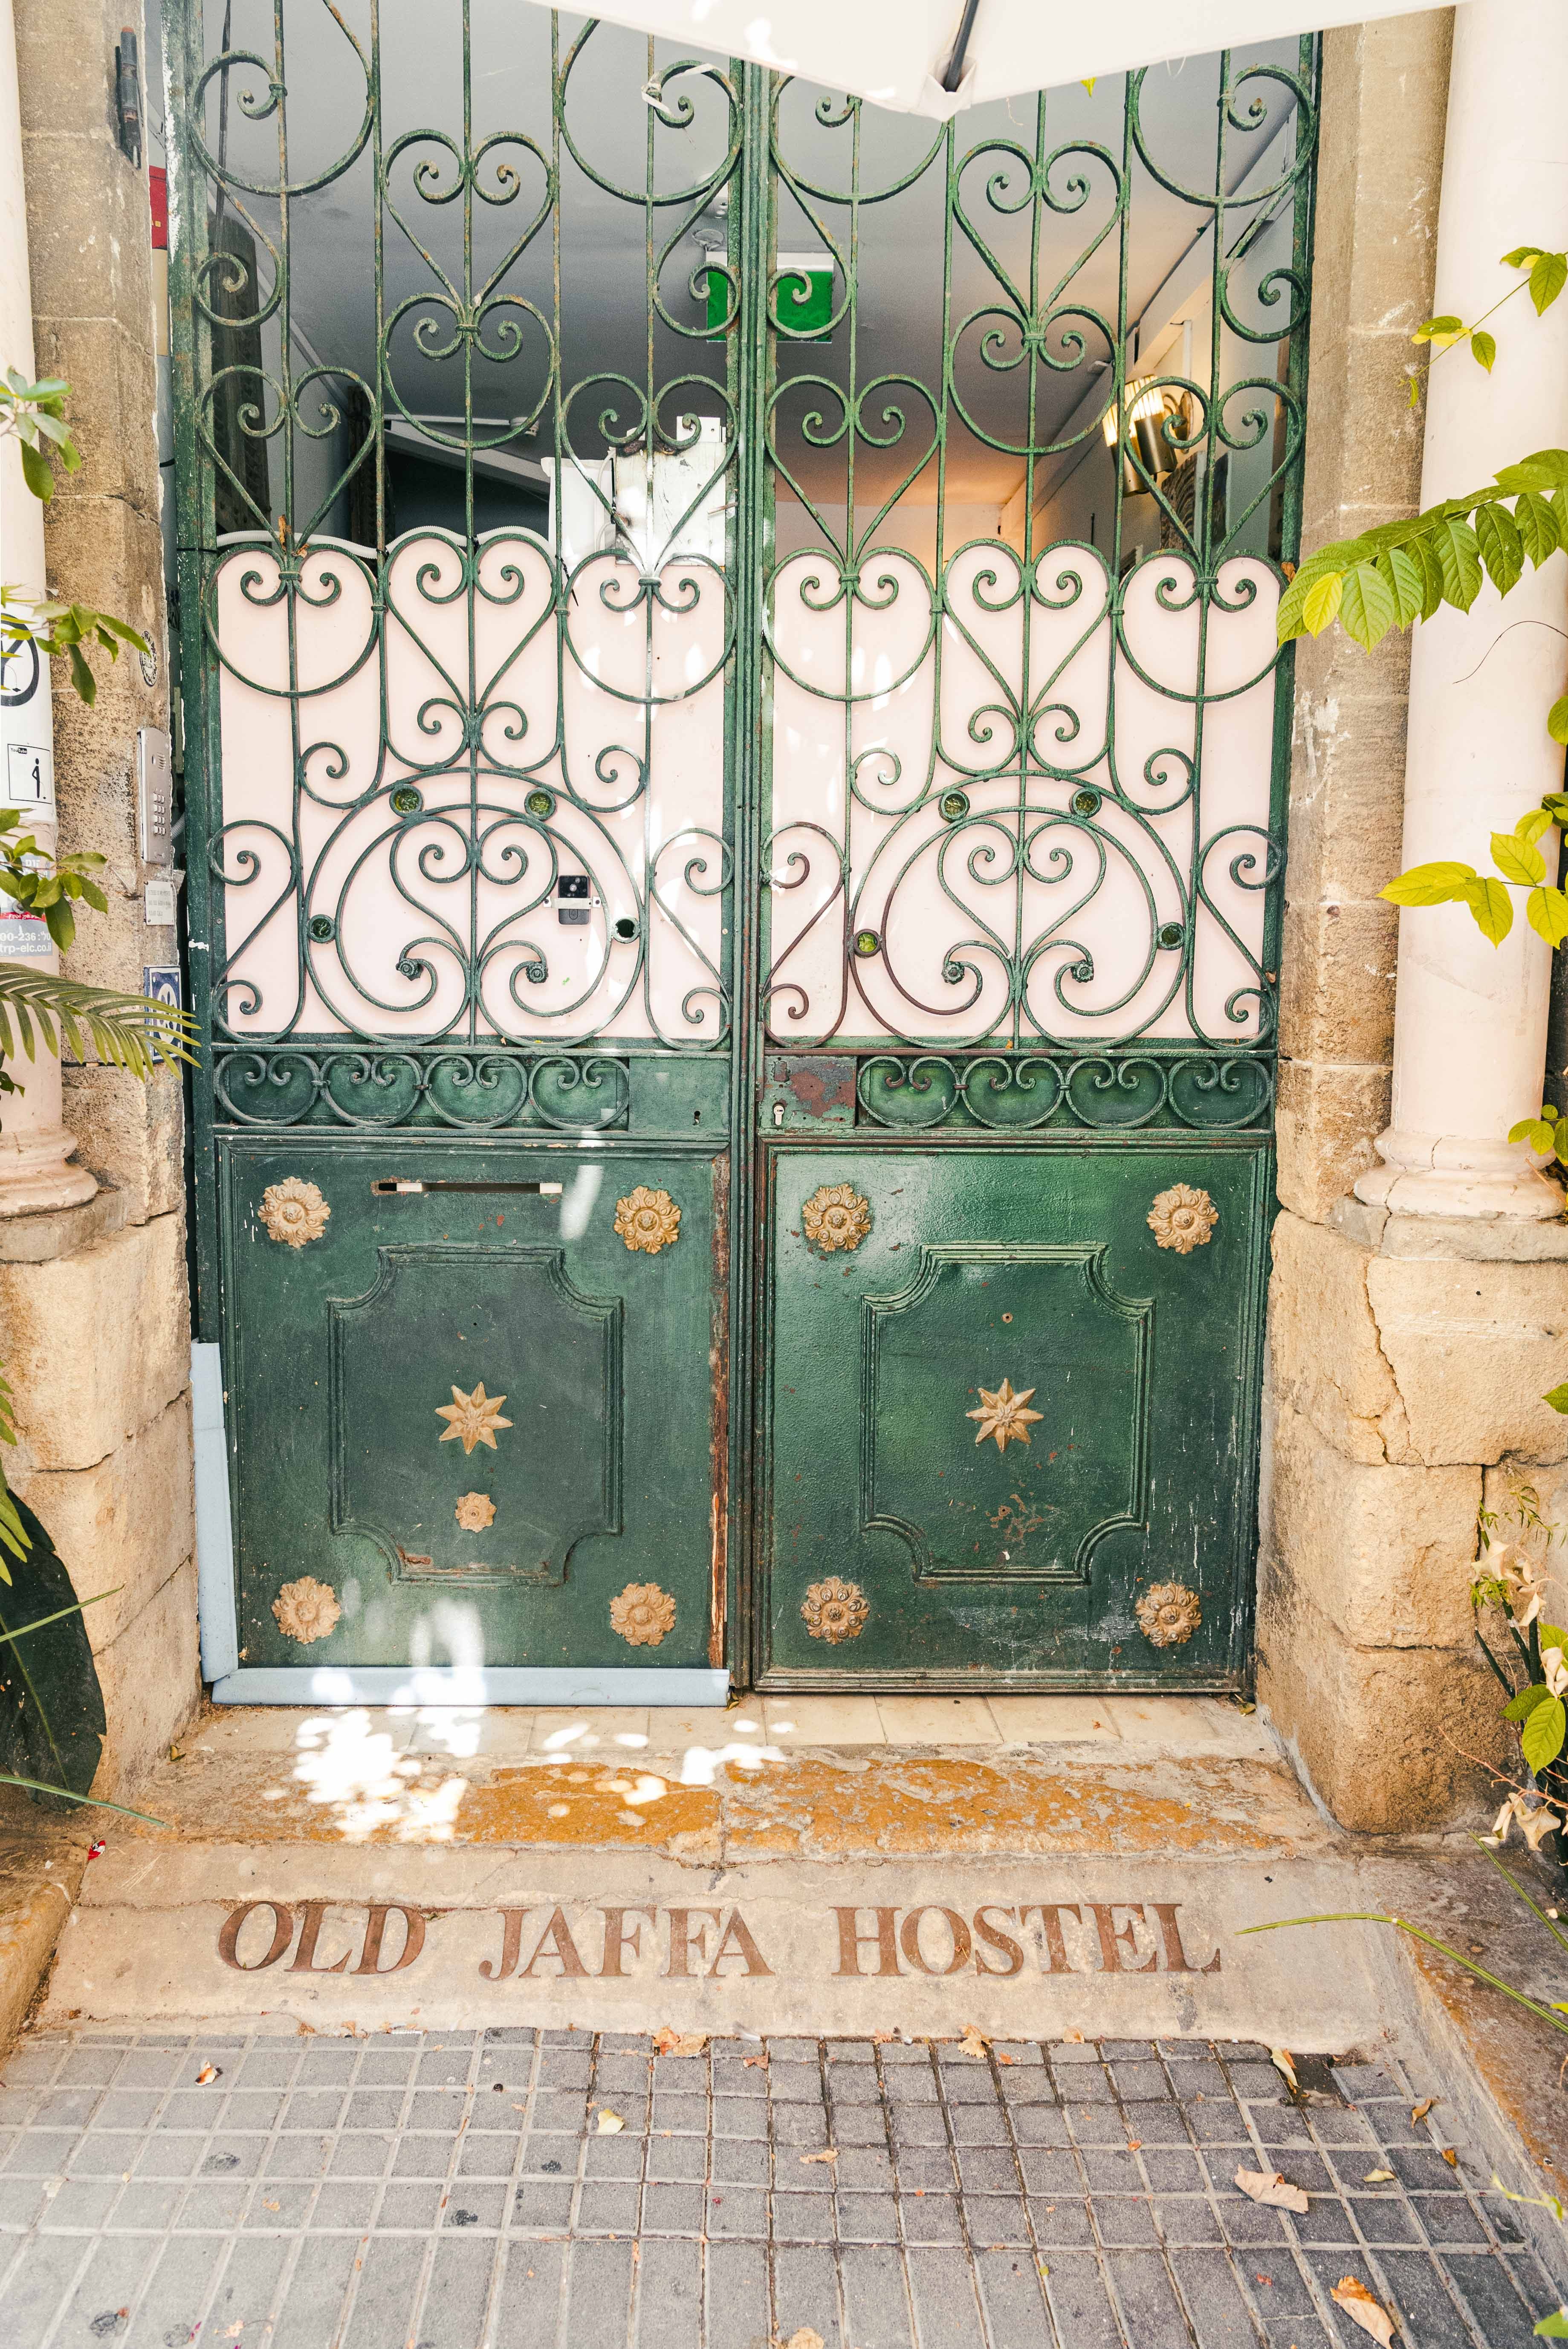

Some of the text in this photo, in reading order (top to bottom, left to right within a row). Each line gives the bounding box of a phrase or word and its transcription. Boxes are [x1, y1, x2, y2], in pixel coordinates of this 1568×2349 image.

[218, 1901, 1221, 1982] OLD JAFFA HOSTEL
